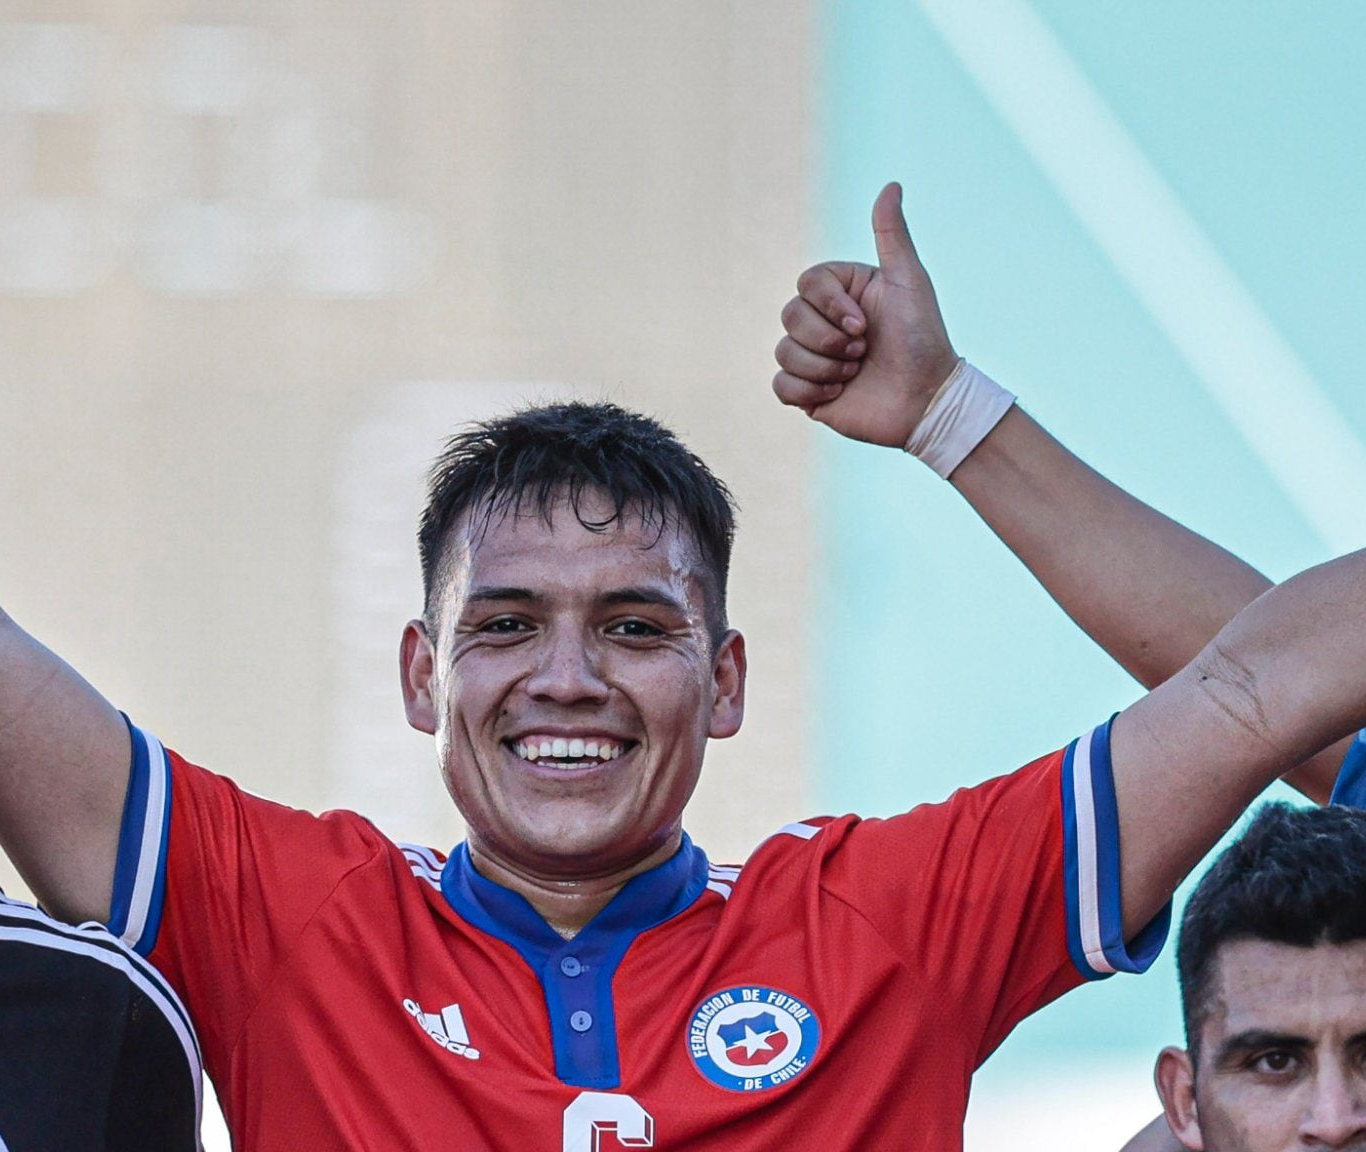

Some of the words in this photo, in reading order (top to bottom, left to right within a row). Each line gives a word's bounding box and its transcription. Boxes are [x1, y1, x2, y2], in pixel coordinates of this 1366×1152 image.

[691, 992, 735, 1058] FEDERACION
[742, 989, 760, 1002] DE
[767, 991, 811, 1024] FUTBOL
[744, 1078, 762, 1090] DE
[770, 1058, 806, 1085] CHILE
